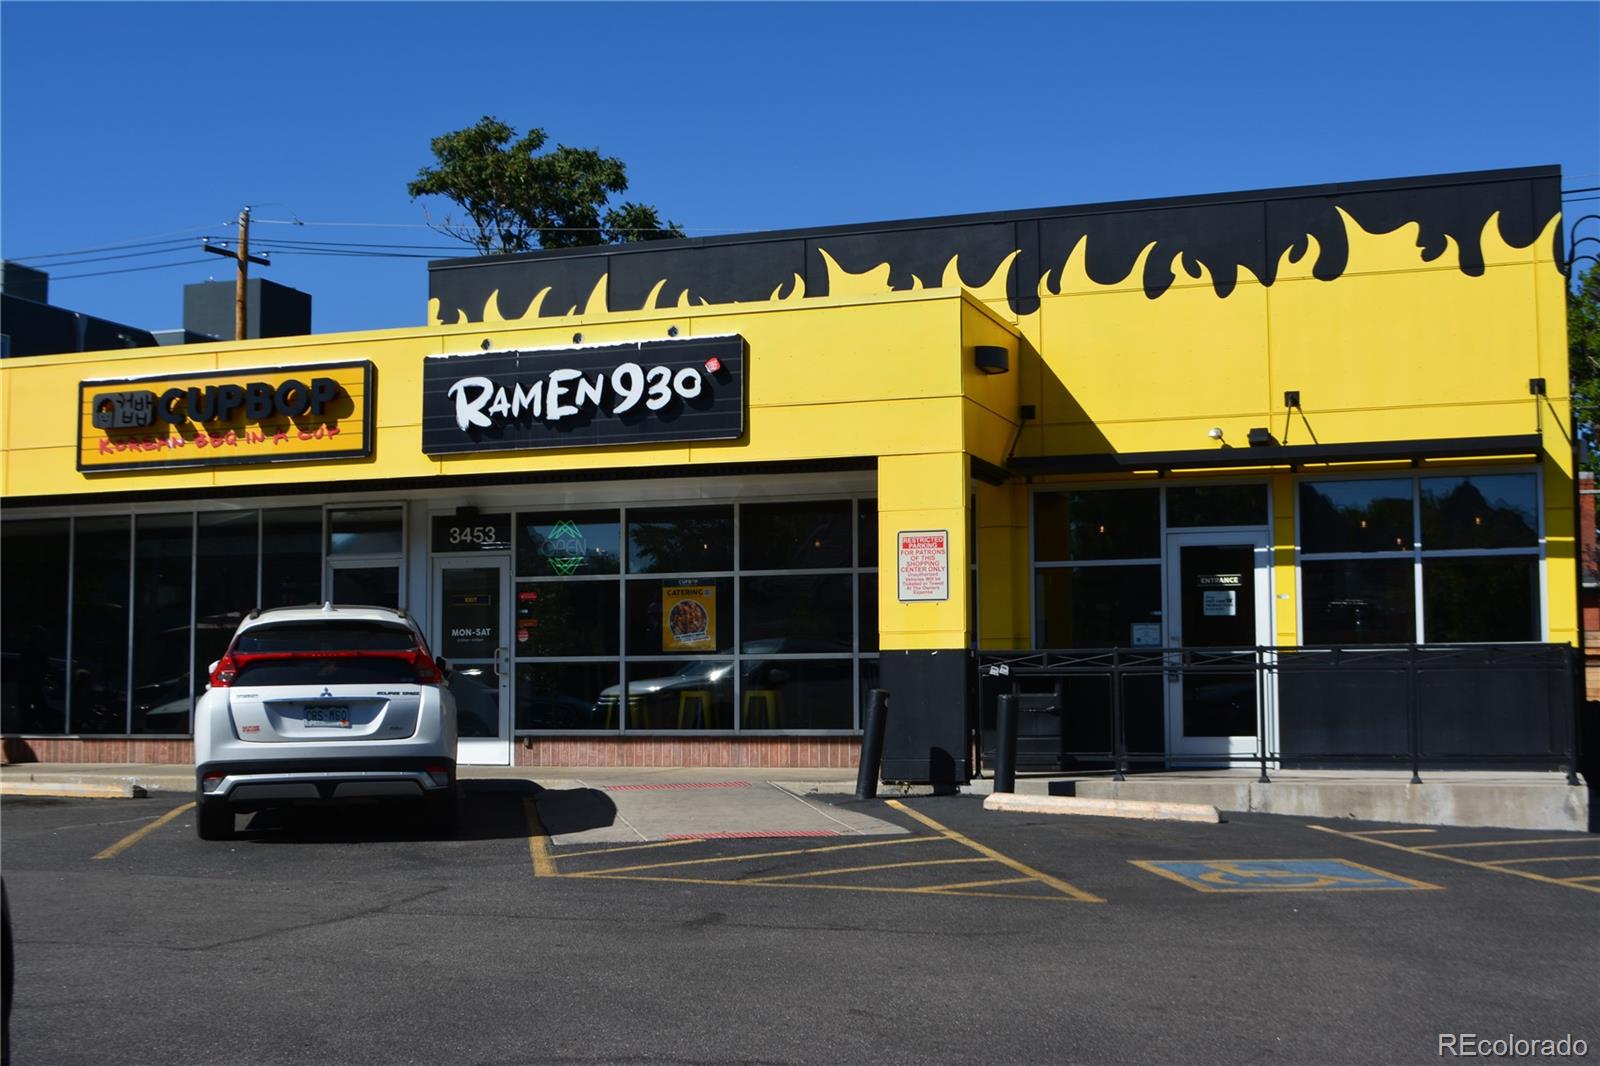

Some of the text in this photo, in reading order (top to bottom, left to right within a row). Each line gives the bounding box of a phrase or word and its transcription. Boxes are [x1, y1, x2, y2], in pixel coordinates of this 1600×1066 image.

[611, 362, 702, 414] 930
[158, 377, 339, 424] CUPBOP
[98, 425, 341, 455] KOREAN BBQ IN A CUP
[449, 526, 496, 544] 3453
[902, 536, 944, 544] RESTRICTED
[541, 538, 587, 557] OPEN
[451, 627, 491, 637] MON-SAT
